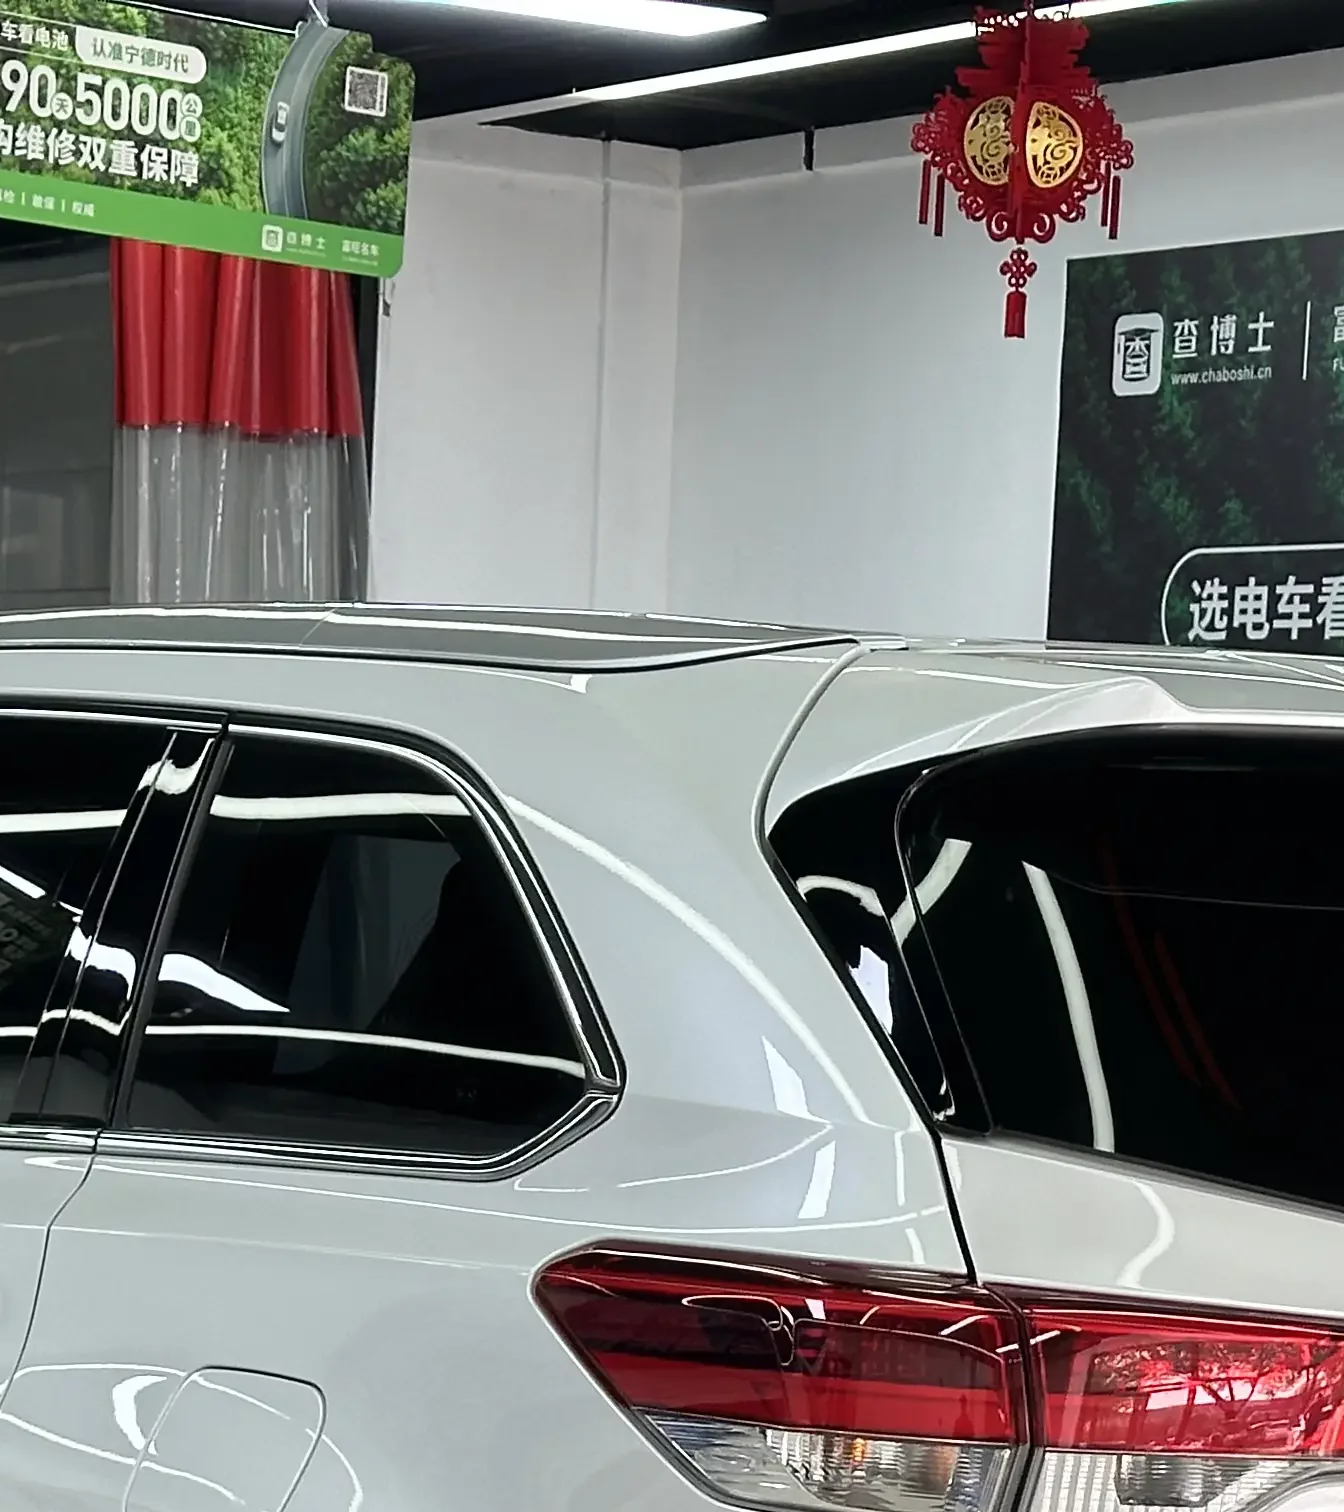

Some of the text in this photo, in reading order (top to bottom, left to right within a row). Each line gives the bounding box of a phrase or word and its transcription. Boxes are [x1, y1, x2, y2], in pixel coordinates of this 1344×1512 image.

[92, 37, 189, 73] 认准宁德时代
[1172, 312, 1275, 359] 查博士
[1170, 365, 1273, 385] www.chaboshi.cn
